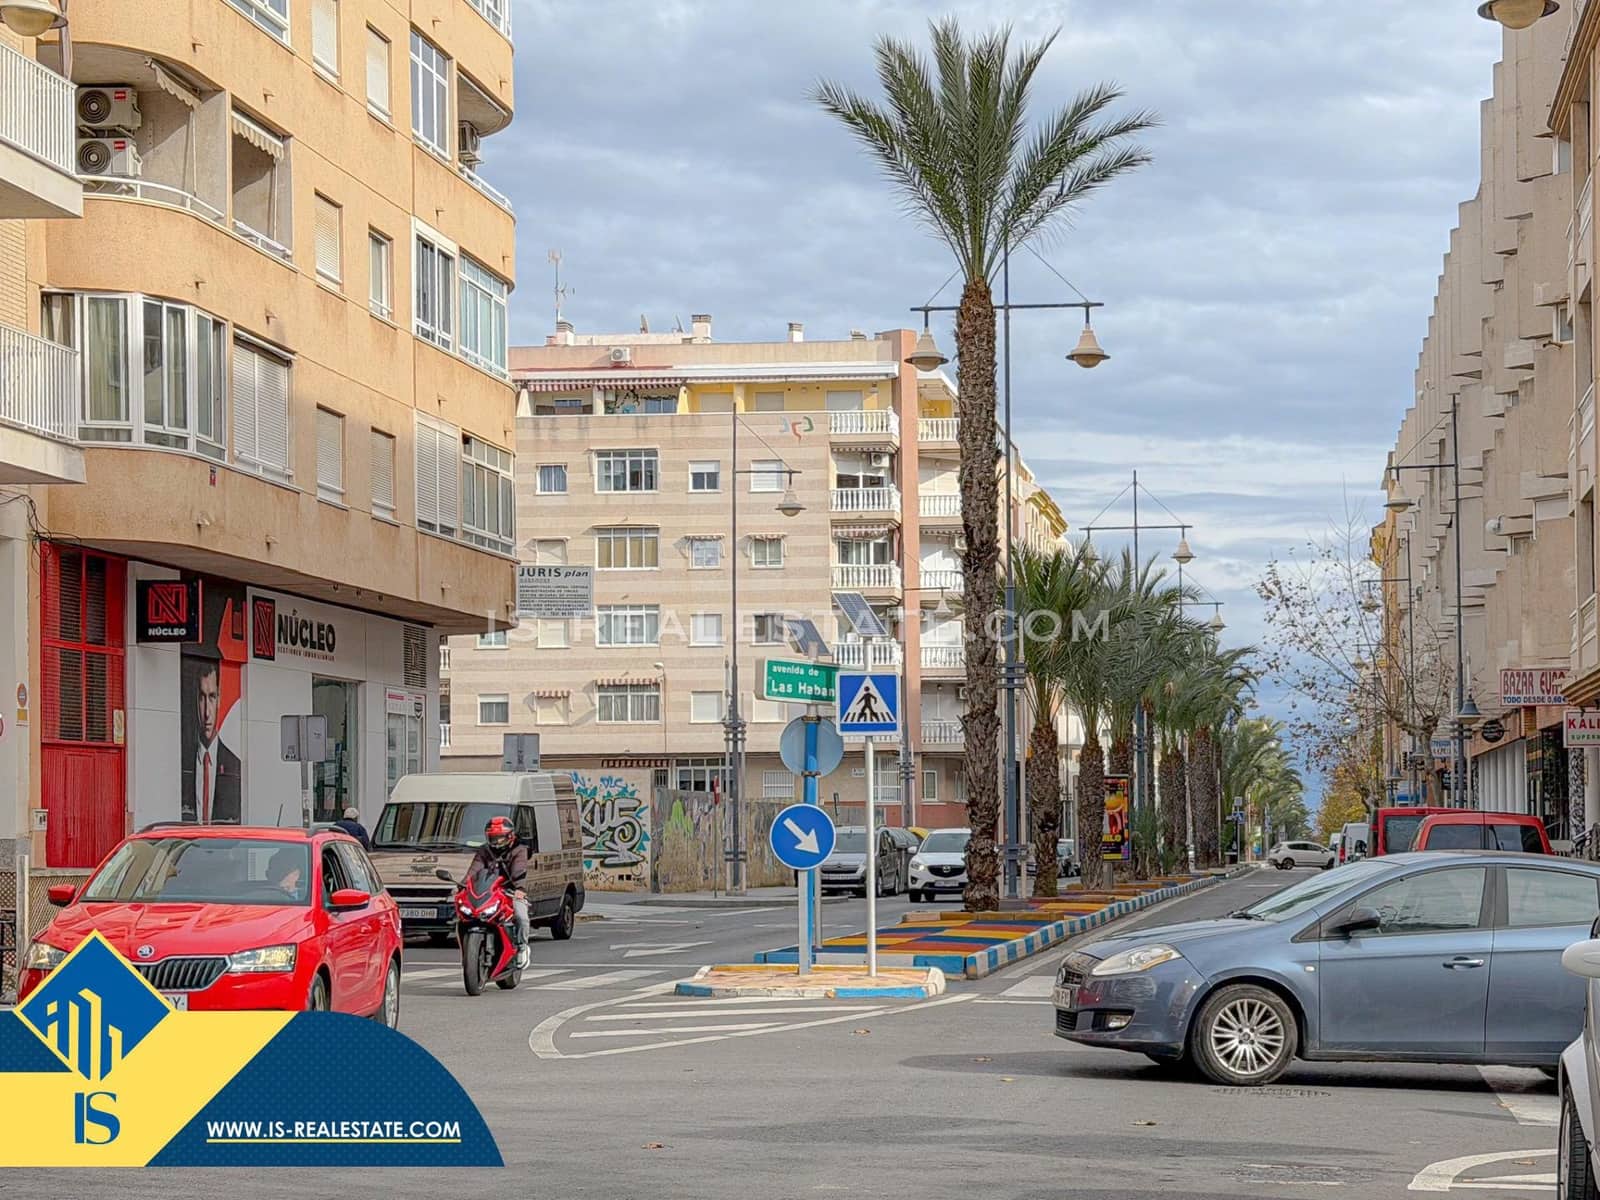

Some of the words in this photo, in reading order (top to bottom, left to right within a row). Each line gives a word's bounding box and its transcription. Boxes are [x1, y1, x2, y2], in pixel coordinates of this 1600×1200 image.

[519, 567, 561, 577] JURIS
[564, 570, 588, 578] plan
[148, 626, 187, 636] NÚCLEO
[278, 608, 336, 653] NÚCLEO
[772, 665, 804, 675] avenida
[771, 680, 793, 693] Las
[1503, 672, 1534, 694] BAZAR
[1503, 696, 1521, 704] TODO
[1523, 696, 1546, 704] DESDE
